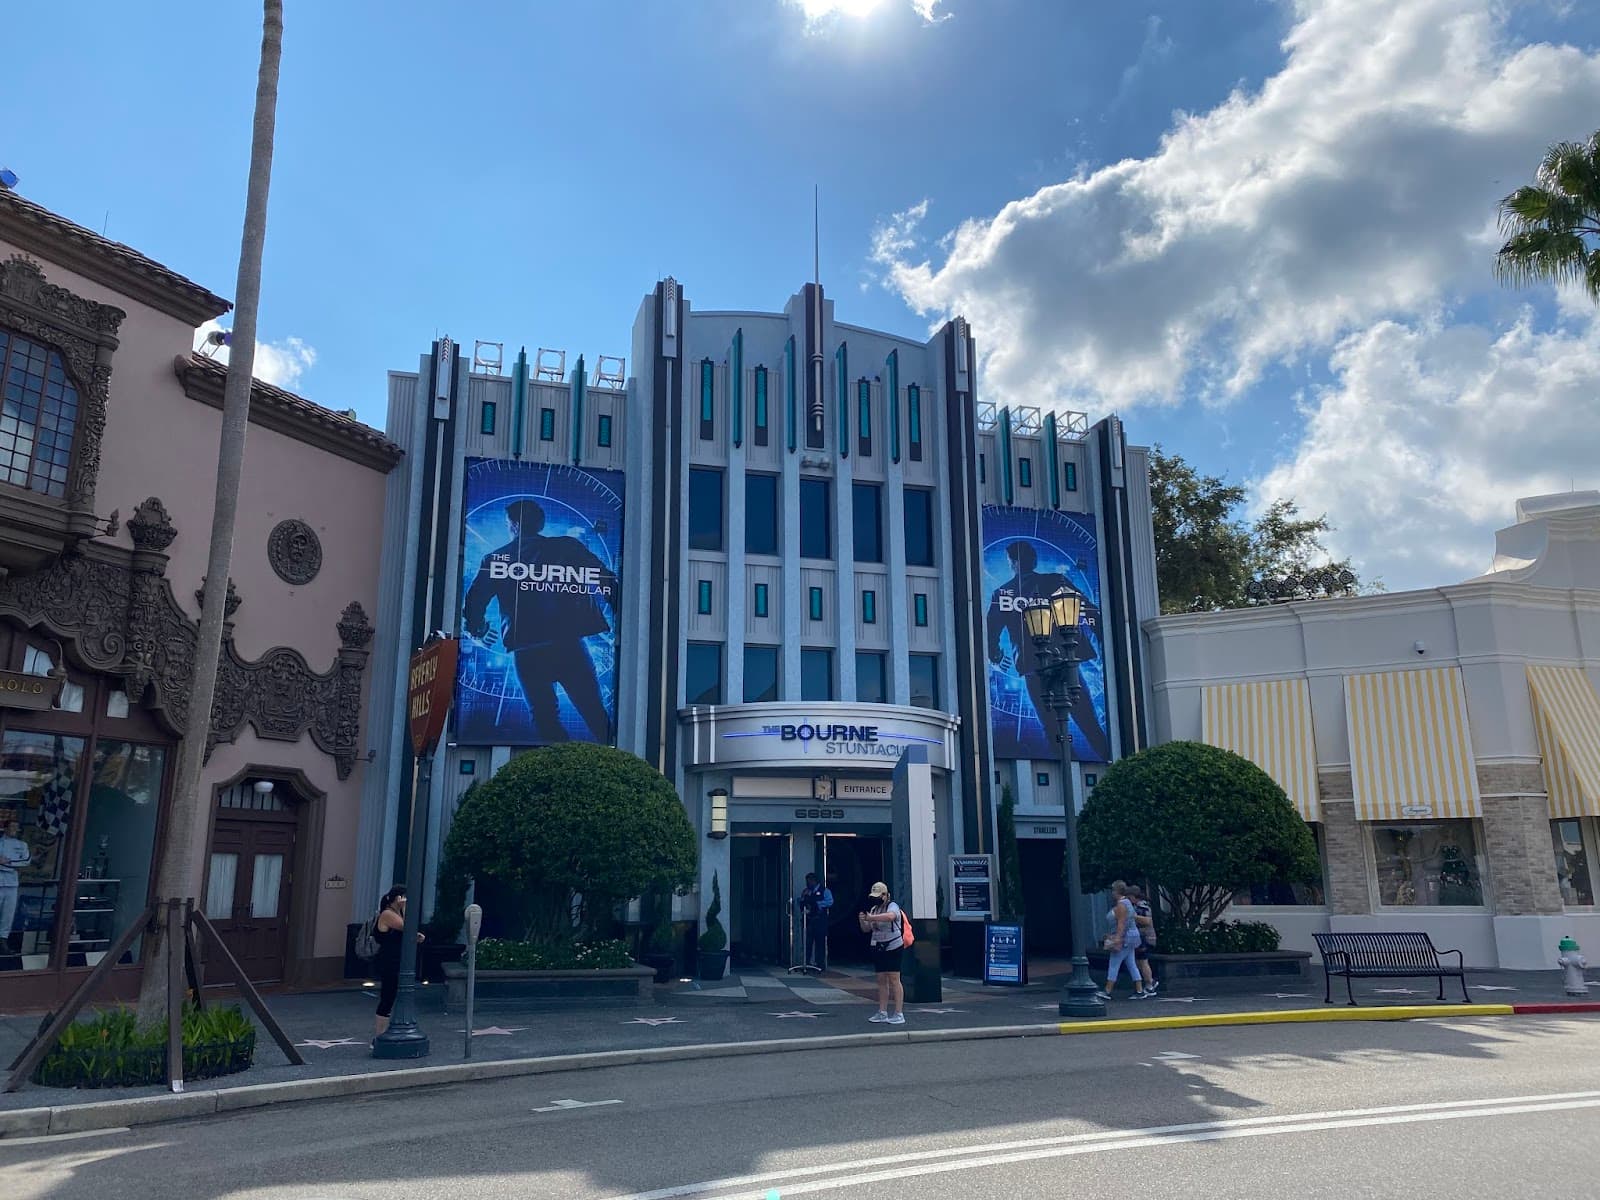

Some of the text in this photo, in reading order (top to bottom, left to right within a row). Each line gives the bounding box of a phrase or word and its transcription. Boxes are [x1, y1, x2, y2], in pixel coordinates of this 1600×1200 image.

[490, 561, 600, 585] BOURNE
[519, 581, 611, 596] STUNTACULAR
[1000, 588, 1014, 596] THE
[411, 690, 431, 720] HILLS
[762, 724, 878, 742] THE BOURNE
[825, 742, 905, 757] STUNTACU
[844, 785, 887, 794] ENTRANCE
